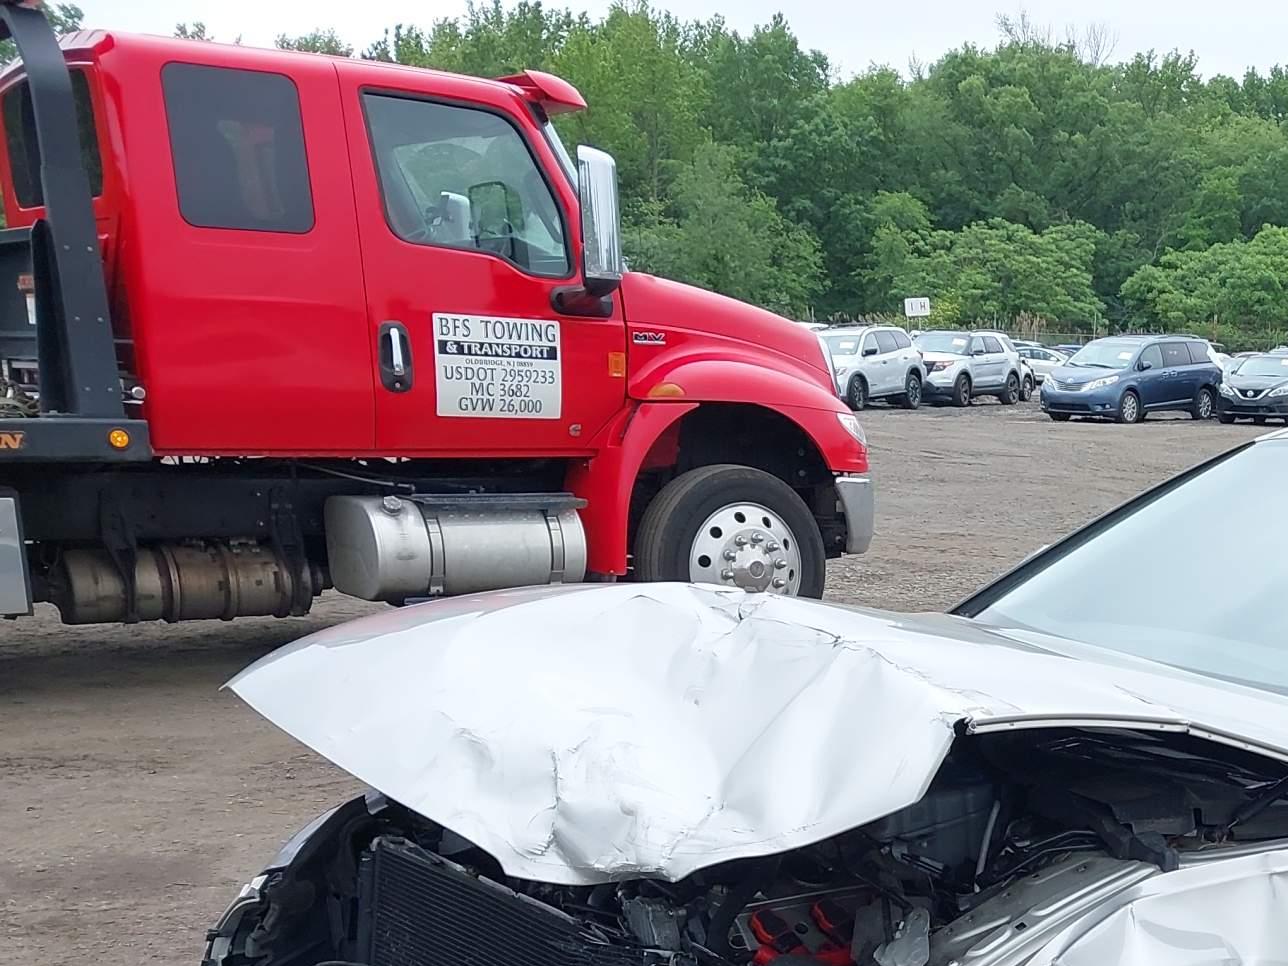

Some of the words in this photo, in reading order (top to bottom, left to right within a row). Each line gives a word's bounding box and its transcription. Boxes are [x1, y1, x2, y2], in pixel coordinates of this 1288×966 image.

[438, 317, 471, 338] BFS
[479, 319, 556, 343] TOWING
[446, 341, 458, 354] &
[460, 342, 550, 359] TRANSPORT
[443, 365, 497, 382] USDOT
[501, 368, 556, 385] 2959233
[470, 382, 495, 397] MC
[499, 383, 531, 398] 3682
[458, 397, 495, 412] GVW
[499, 398, 543, 415] 26,000
